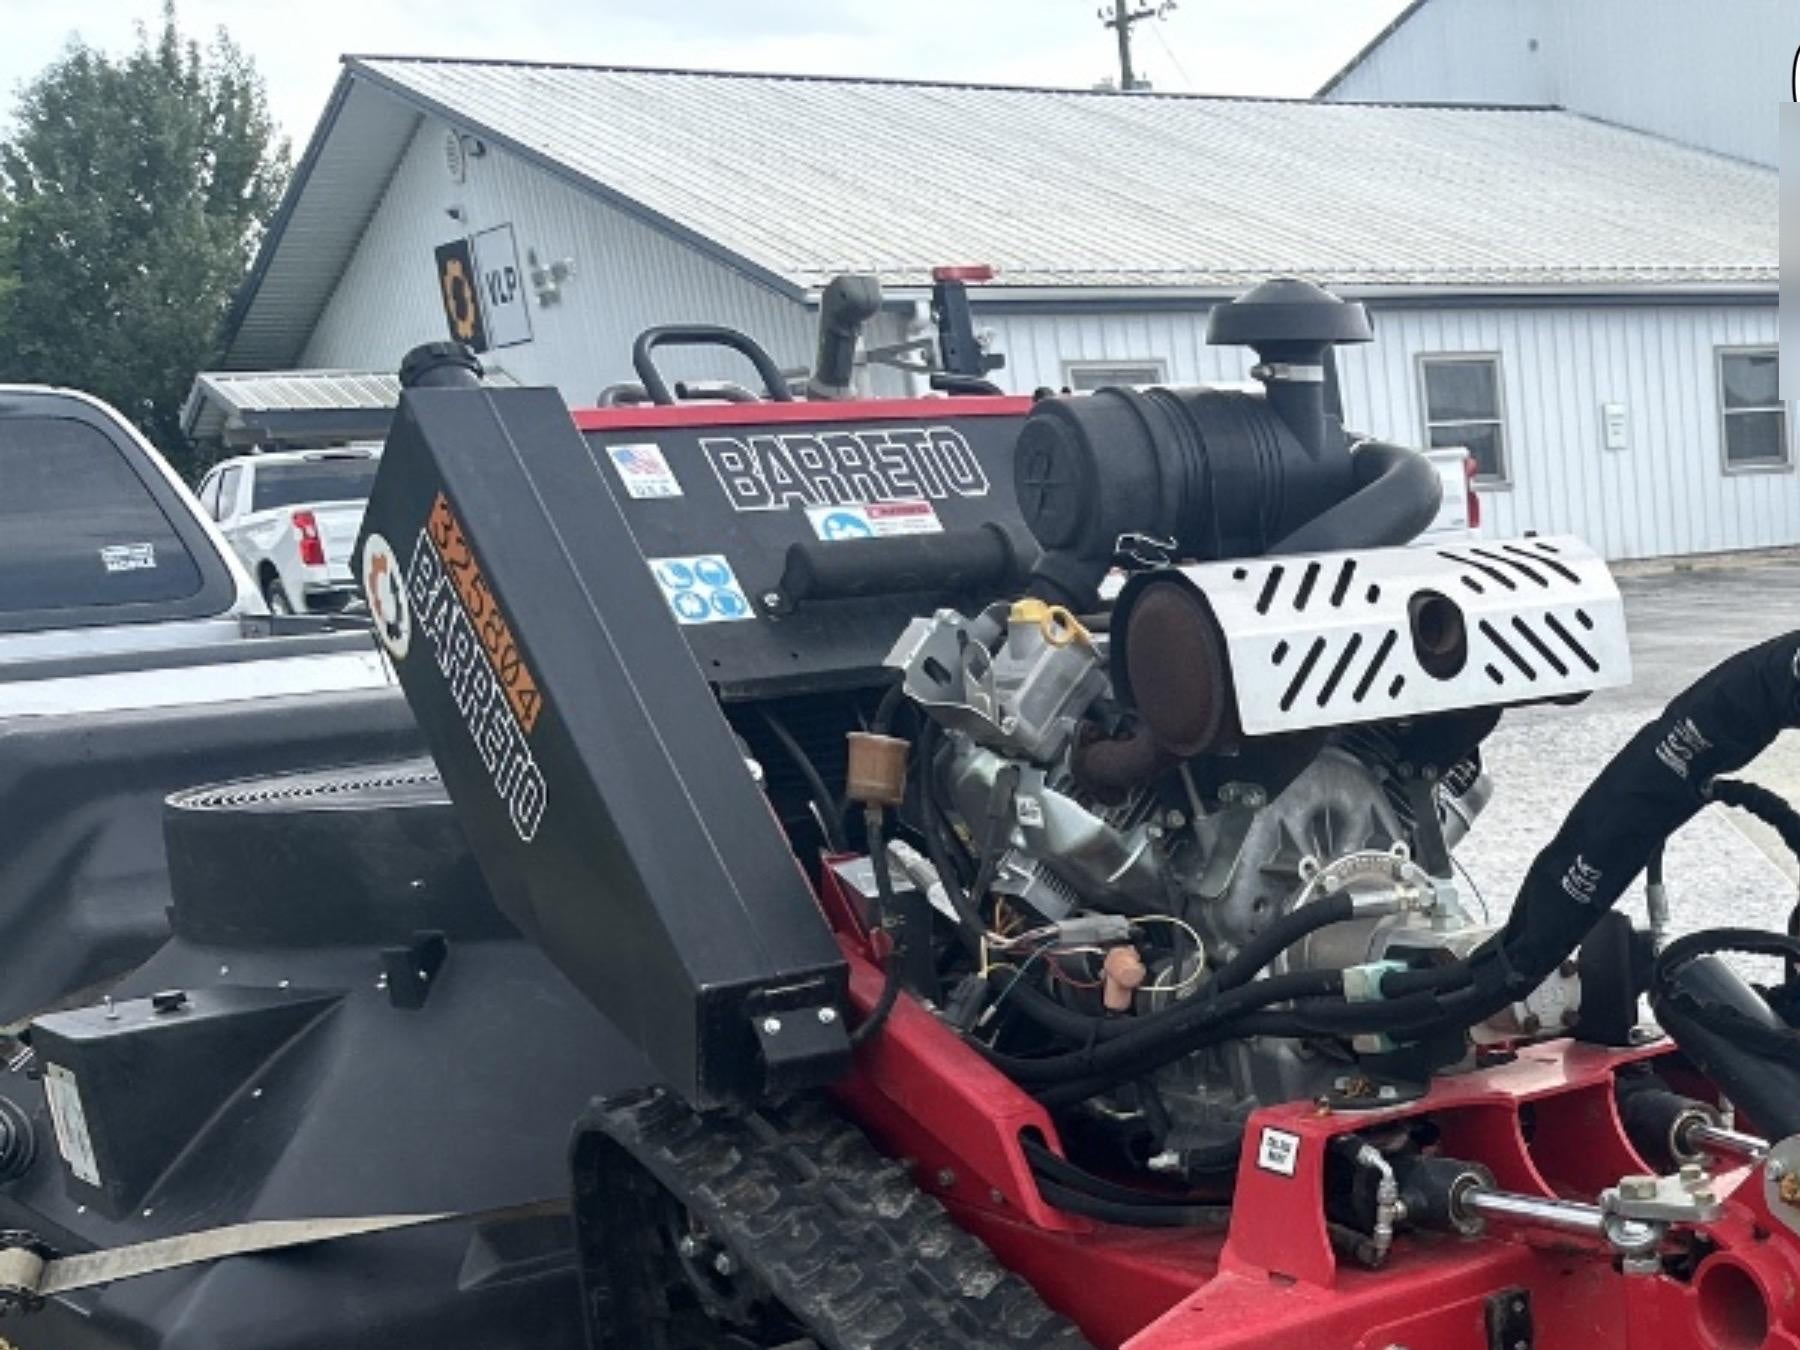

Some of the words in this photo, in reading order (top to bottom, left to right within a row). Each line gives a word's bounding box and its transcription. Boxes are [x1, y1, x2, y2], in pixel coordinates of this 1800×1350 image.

[698, 426, 990, 512] BARRETO
[406, 527, 547, 842] BARRETO
[433, 499, 540, 724] 325804
